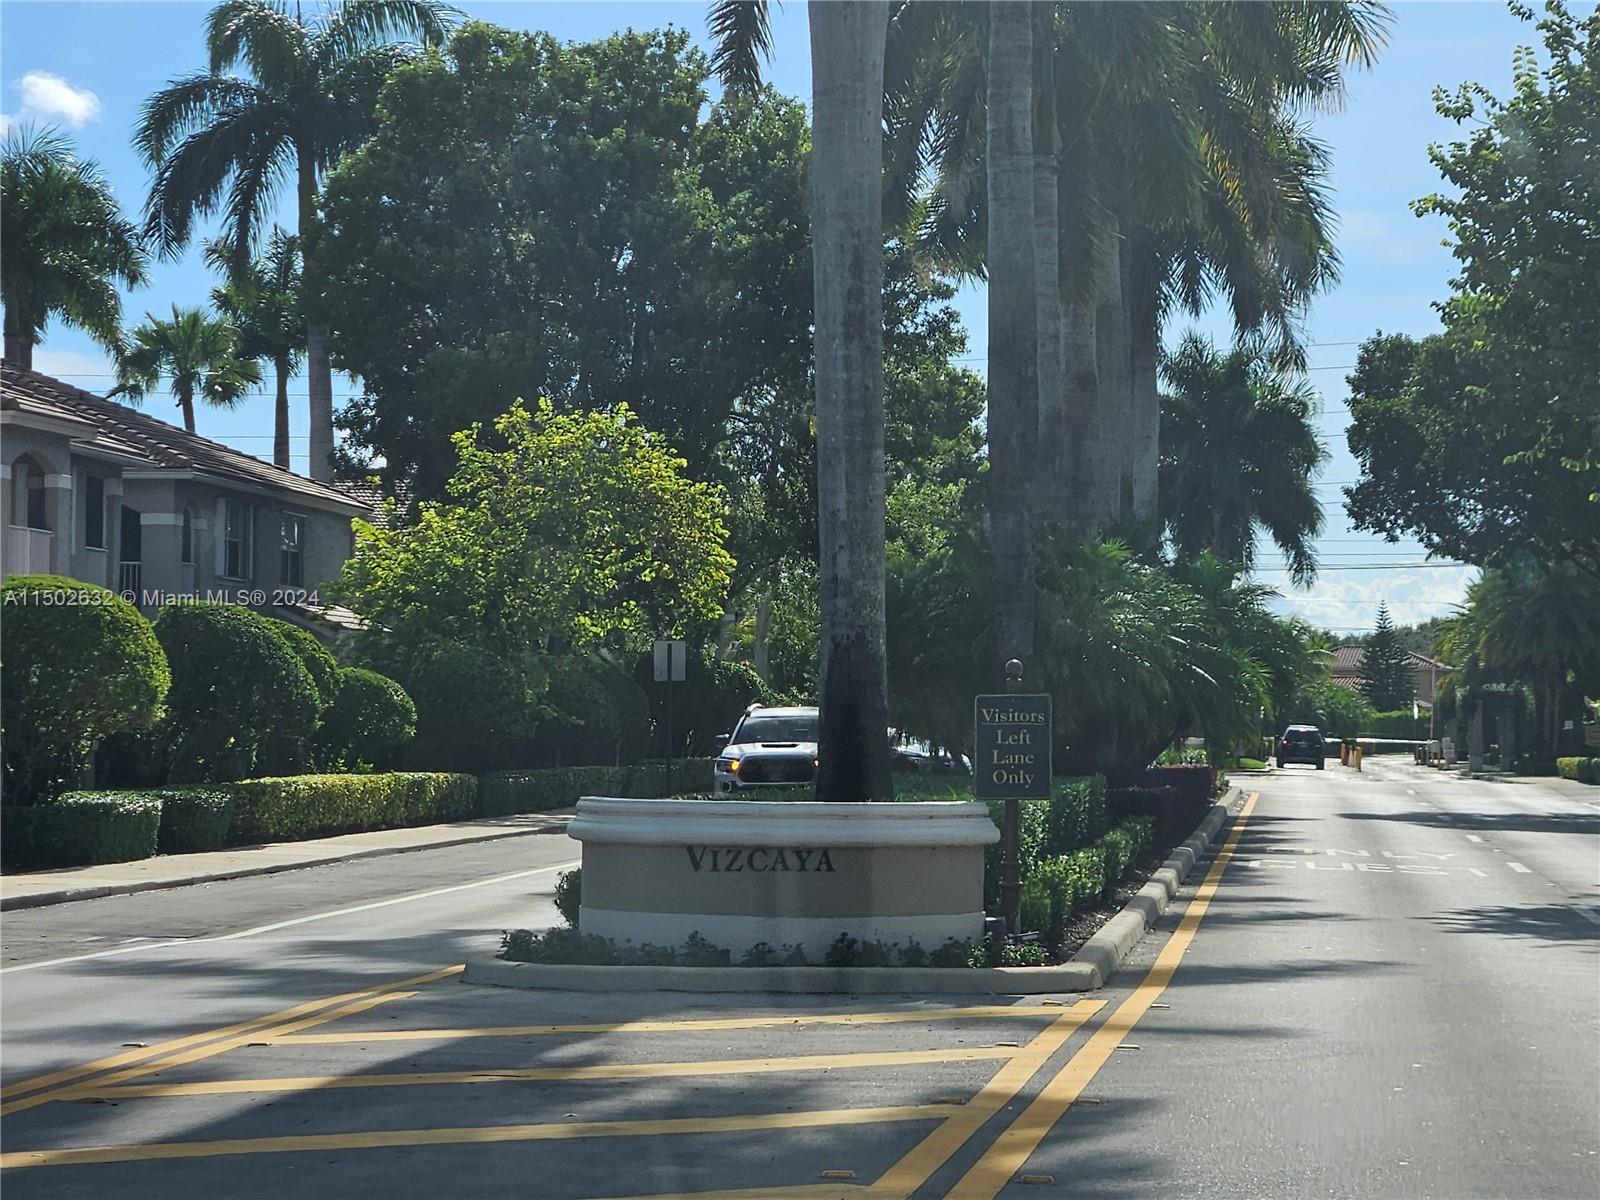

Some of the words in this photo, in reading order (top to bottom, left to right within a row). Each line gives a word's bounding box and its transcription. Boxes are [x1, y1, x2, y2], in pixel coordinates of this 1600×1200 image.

[981, 708, 1046, 722] Visitors
[996, 729, 1032, 745] Left
[992, 749, 1035, 764] Lane
[992, 769, 1035, 789] Only
[686, 844, 837, 872] VIZCAYA
[1266, 847, 1459, 861] ONLY
